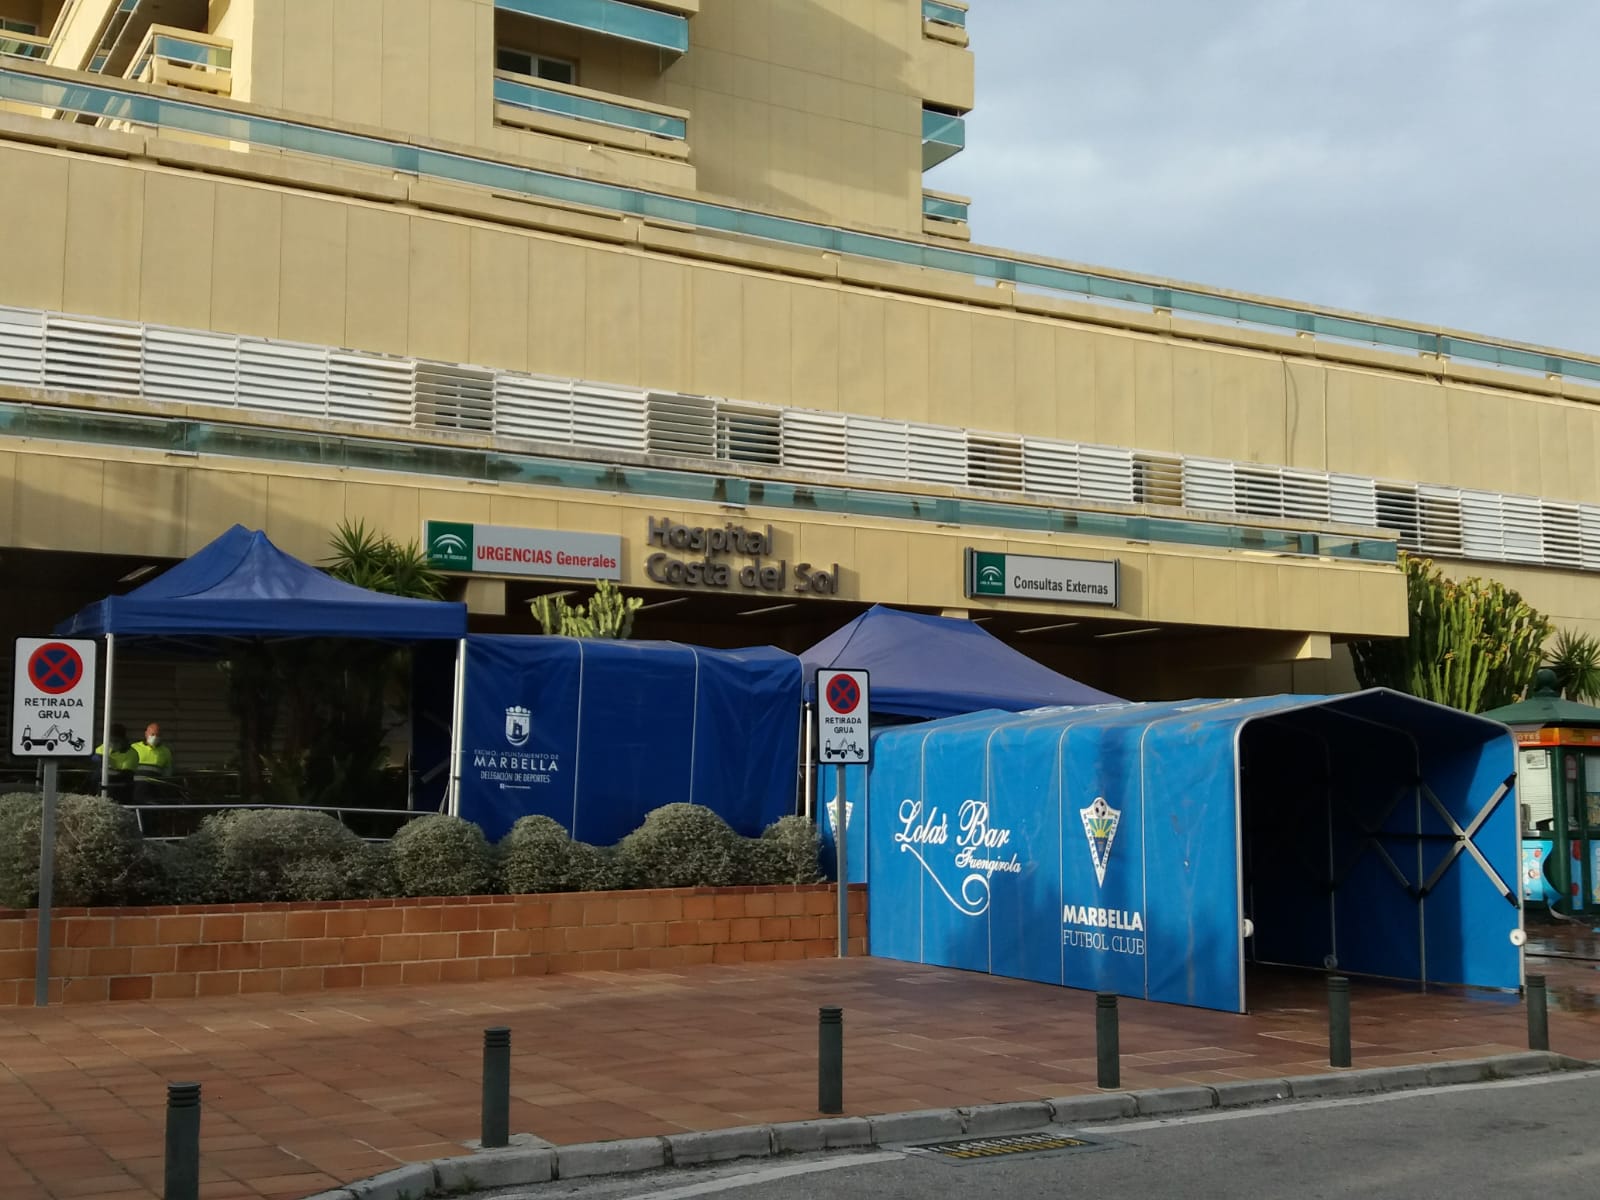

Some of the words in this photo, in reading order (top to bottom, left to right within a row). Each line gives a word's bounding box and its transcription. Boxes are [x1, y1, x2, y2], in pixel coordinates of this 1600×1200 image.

[647, 516, 773, 558] Hospital
[477, 546, 552, 564] URGENCIAS
[556, 551, 617, 568] Generales
[645, 553, 731, 587] Costa
[740, 558, 786, 591] del
[794, 563, 839, 594] Sol
[1014, 576, 1063, 592] Consultas
[1066, 579, 1108, 595] Externas
[24, 697, 84, 707] RETIRADA
[38, 710, 70, 719] GRUA
[834, 726, 854, 734] GRUA
[1516, 733, 1541, 741] OTES
[474, 756, 558, 771] MARBELLA
[514, 773, 522, 781] DE
[523, 774, 551, 783] DEPORTES
[956, 800, 1010, 848] Bar
[955, 847, 1021, 878] Fuengirola
[1063, 904, 1144, 932] MARBELLA
[1063, 930, 1109, 951] FUTBOL
[1111, 936, 1145, 955] CLUB
